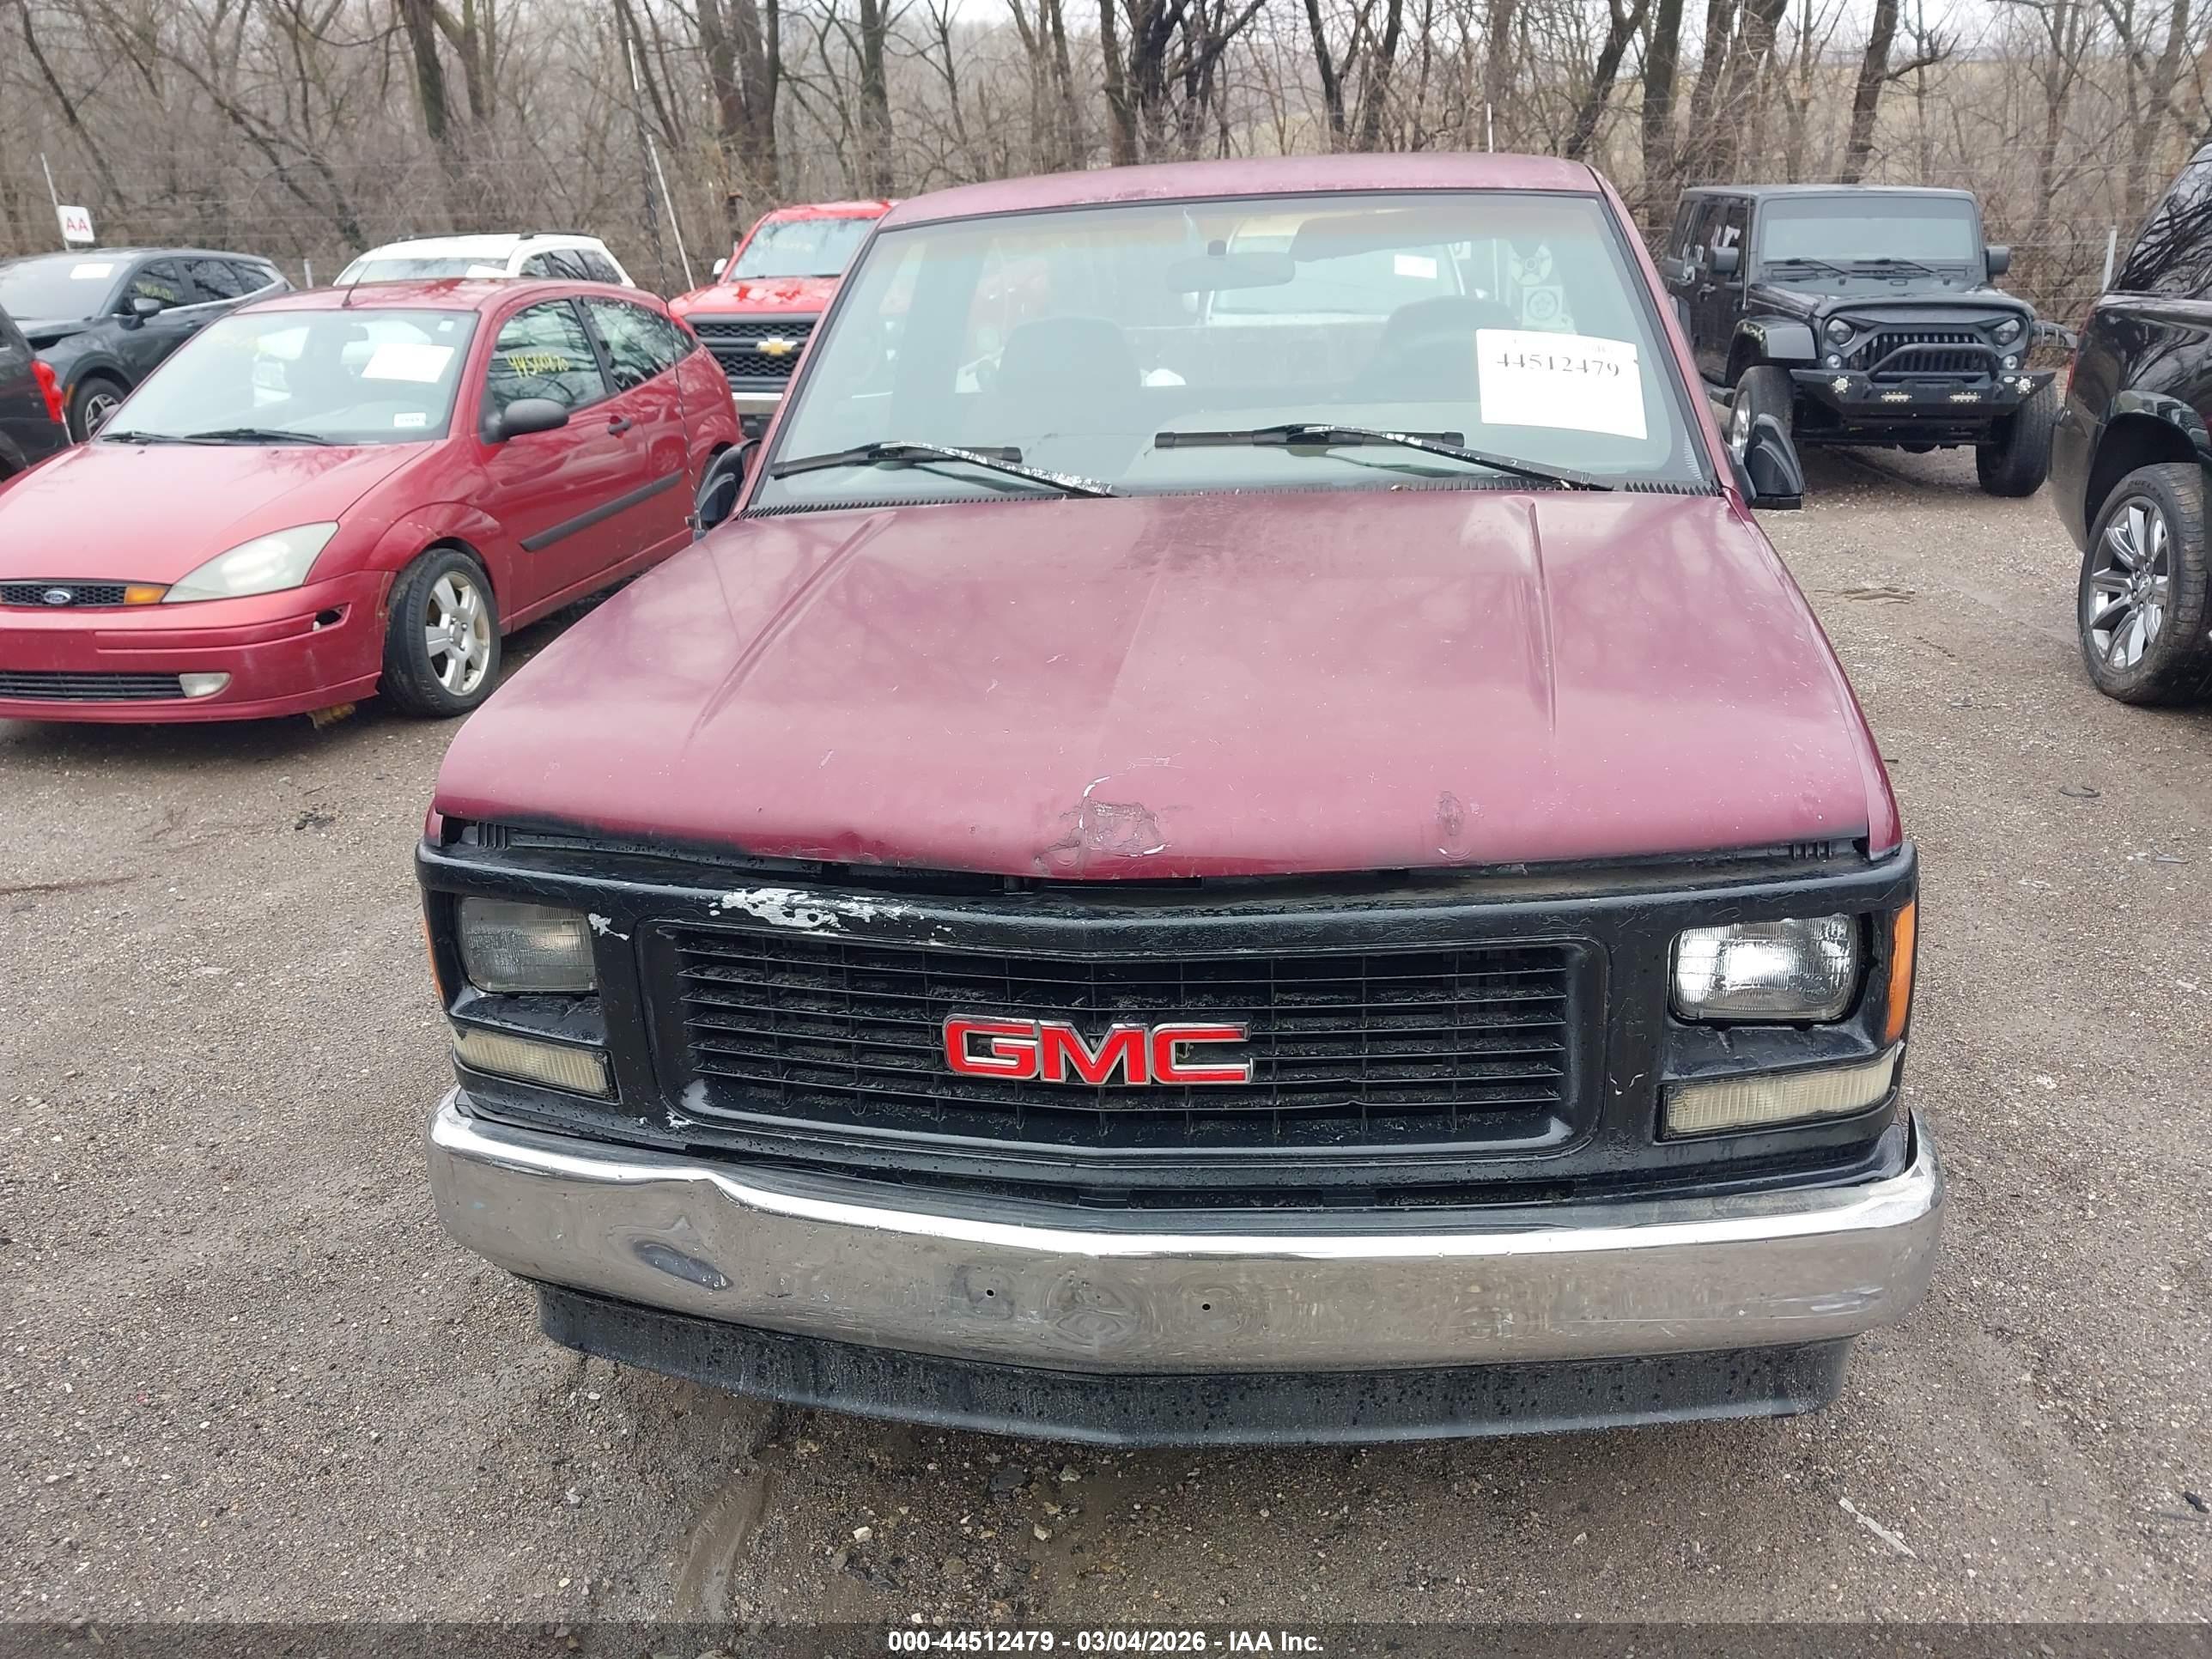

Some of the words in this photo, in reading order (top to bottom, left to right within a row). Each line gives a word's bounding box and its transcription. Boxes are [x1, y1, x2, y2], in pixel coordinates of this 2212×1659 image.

[67, 216, 88, 232] AA
[1497, 352, 1620, 377] 44512479
[943, 1013, 1253, 1085] GMC
